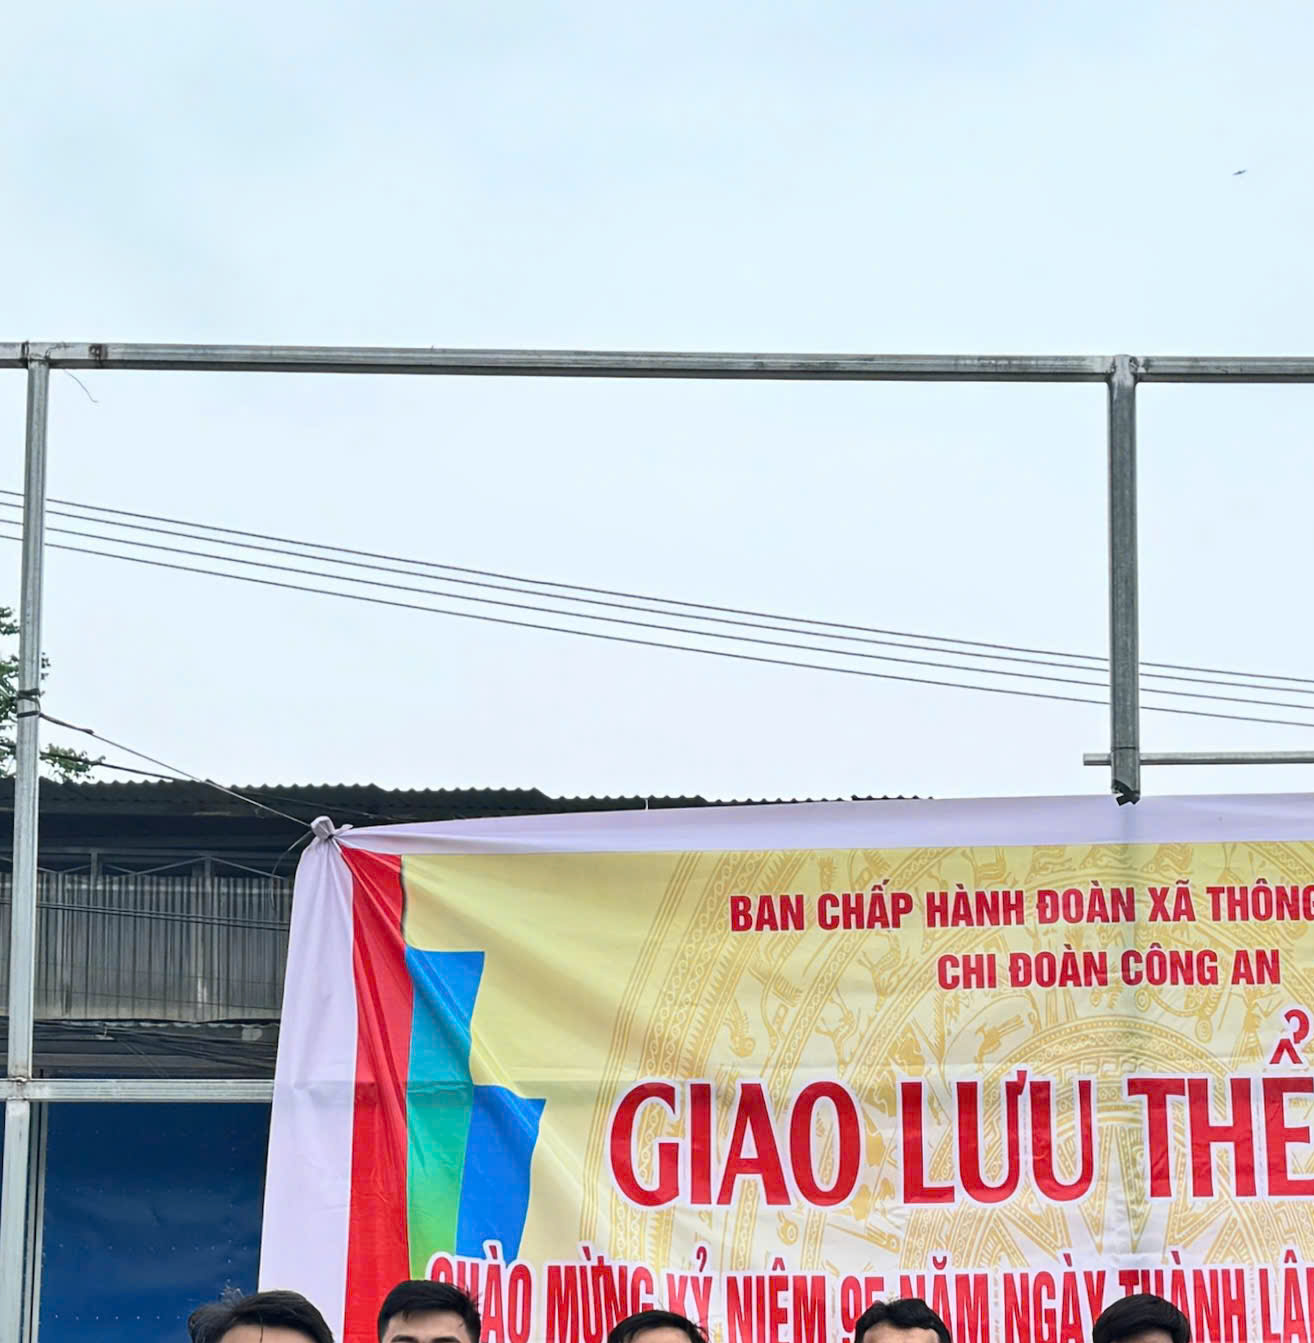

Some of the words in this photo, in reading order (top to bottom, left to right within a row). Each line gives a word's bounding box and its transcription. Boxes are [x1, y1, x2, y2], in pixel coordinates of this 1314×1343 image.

[730, 895, 804, 932] BAN
[818, 879, 913, 929] CHẤP
[926, 884, 1025, 928] HÀNH
[1037, 880, 1136, 924] ĐOÀN
[1148, 880, 1196, 922] XÃ
[938, 953, 996, 989] CHI
[1009, 944, 1107, 988] ĐOÀN
[1121, 943, 1218, 986] CÔNG
[1231, 949, 1281, 985] AN
[610, 1081, 861, 1207] GIAO
[901, 1070, 1095, 1204] LƯU
